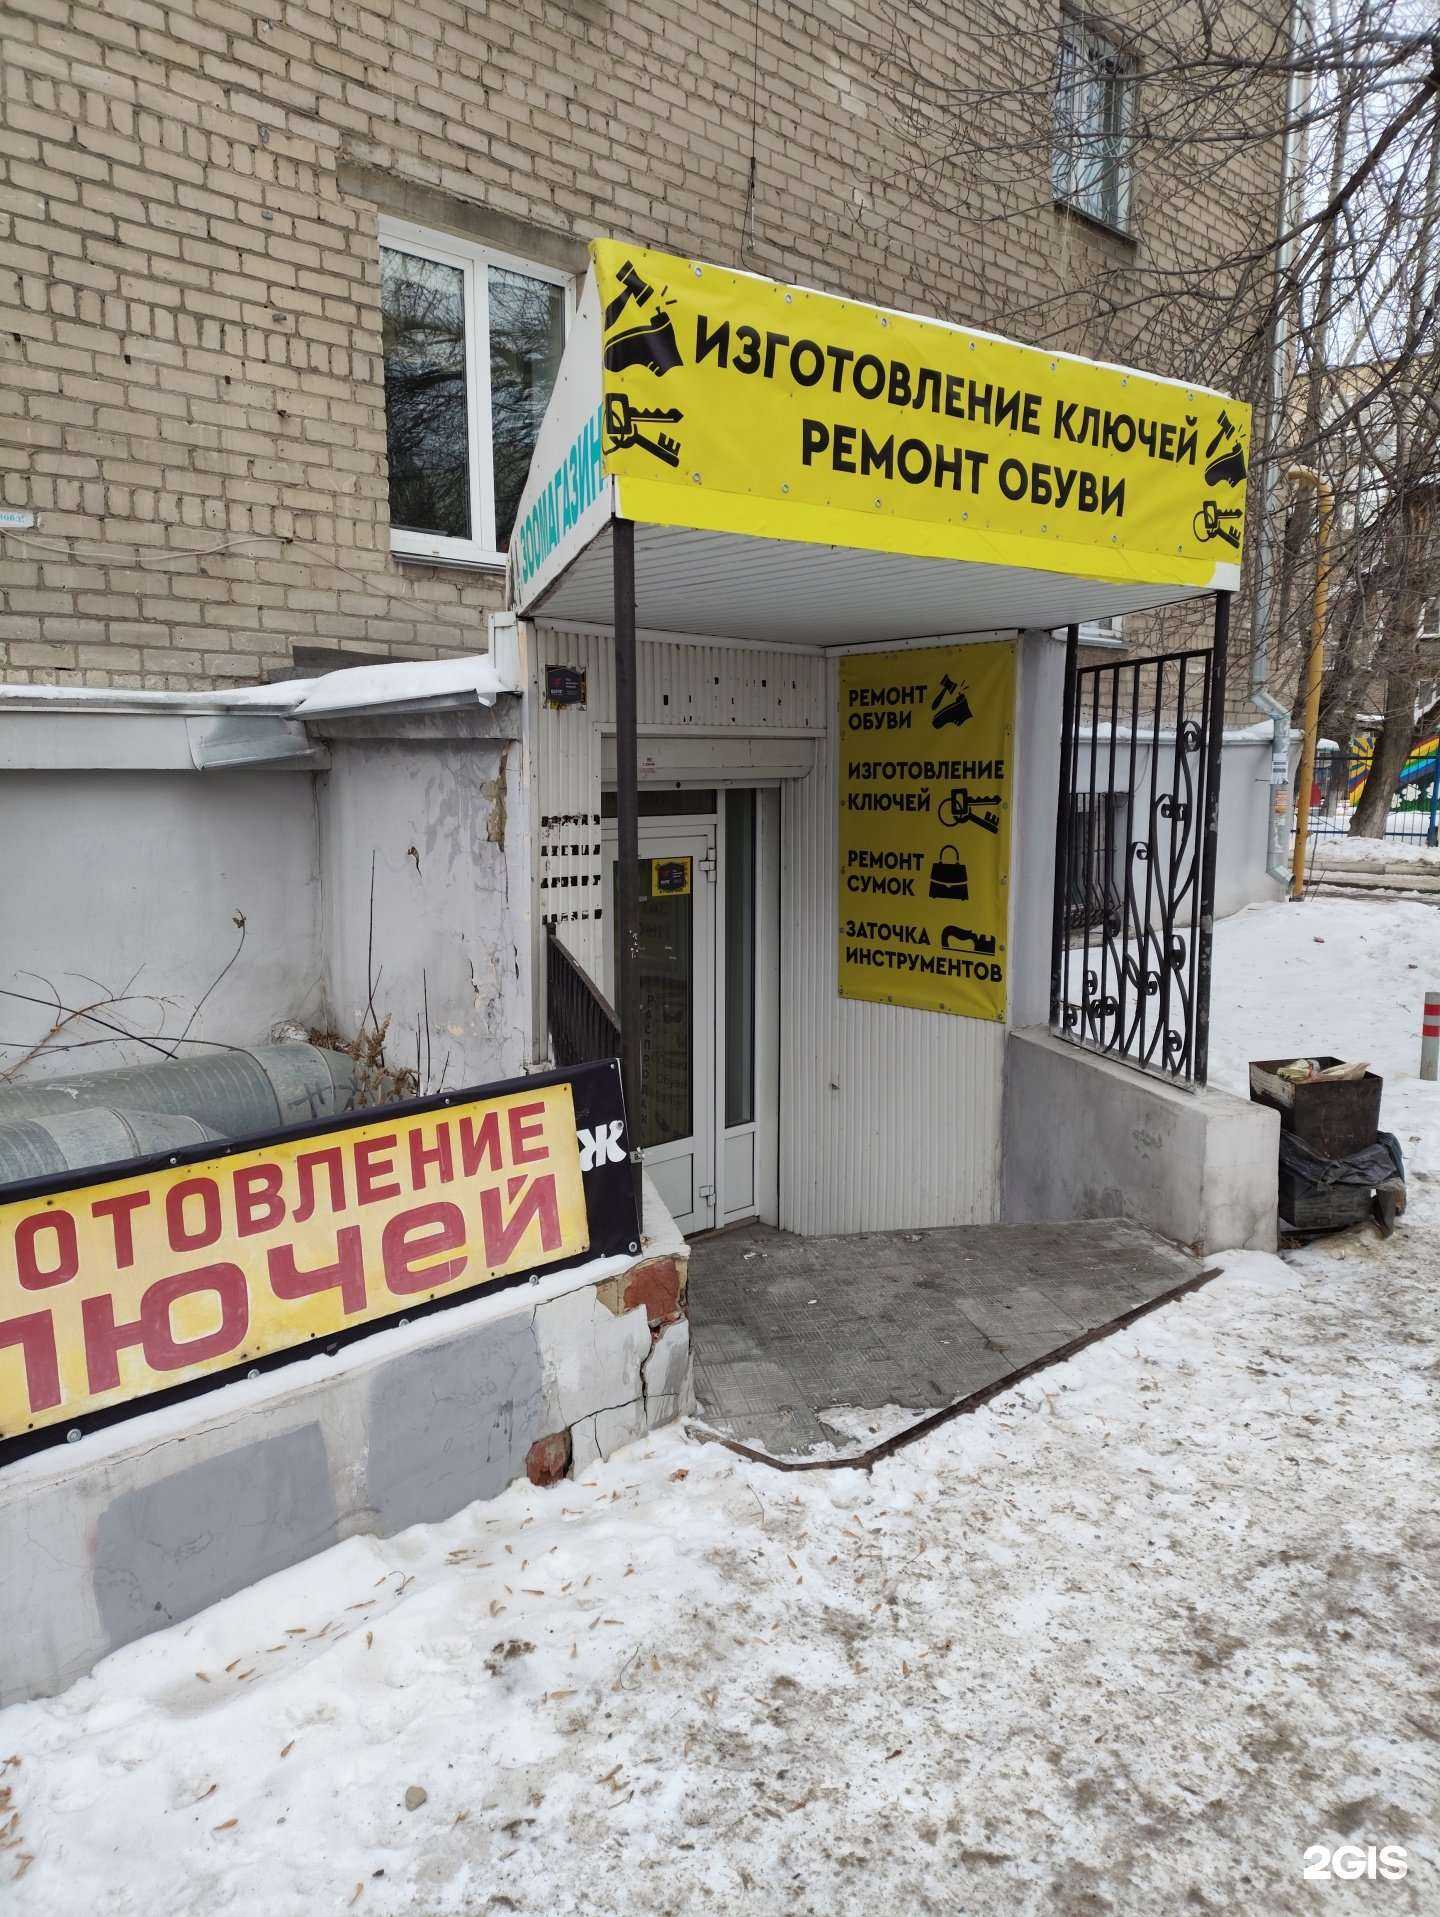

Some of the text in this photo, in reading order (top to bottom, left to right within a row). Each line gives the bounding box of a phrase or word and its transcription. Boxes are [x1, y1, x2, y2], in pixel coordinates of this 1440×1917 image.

[695, 314, 1198, 466] ИЗГОТОВЛЕНИЕ КЛЮЧЕЙ
[801, 418, 1126, 518] РЕМОНТ ОБУВИ
[519, 404, 604, 584] ЗООМАГАЗИН
[848, 685, 927, 707] РЕМОНТ
[848, 711, 912, 731] ОБУВИ
[848, 760, 1004, 779] ИЗГОТОВЛЕНИЕ
[848, 787, 930, 812] КЛЮЧЕЙ
[848, 850, 924, 871] РЕМОНТ
[847, 875, 914, 896] СУМОК
[846, 920, 931, 945] ЗАТОЧКА
[846, 946, 1003, 983] ИНСТРУМЕНТОВ
